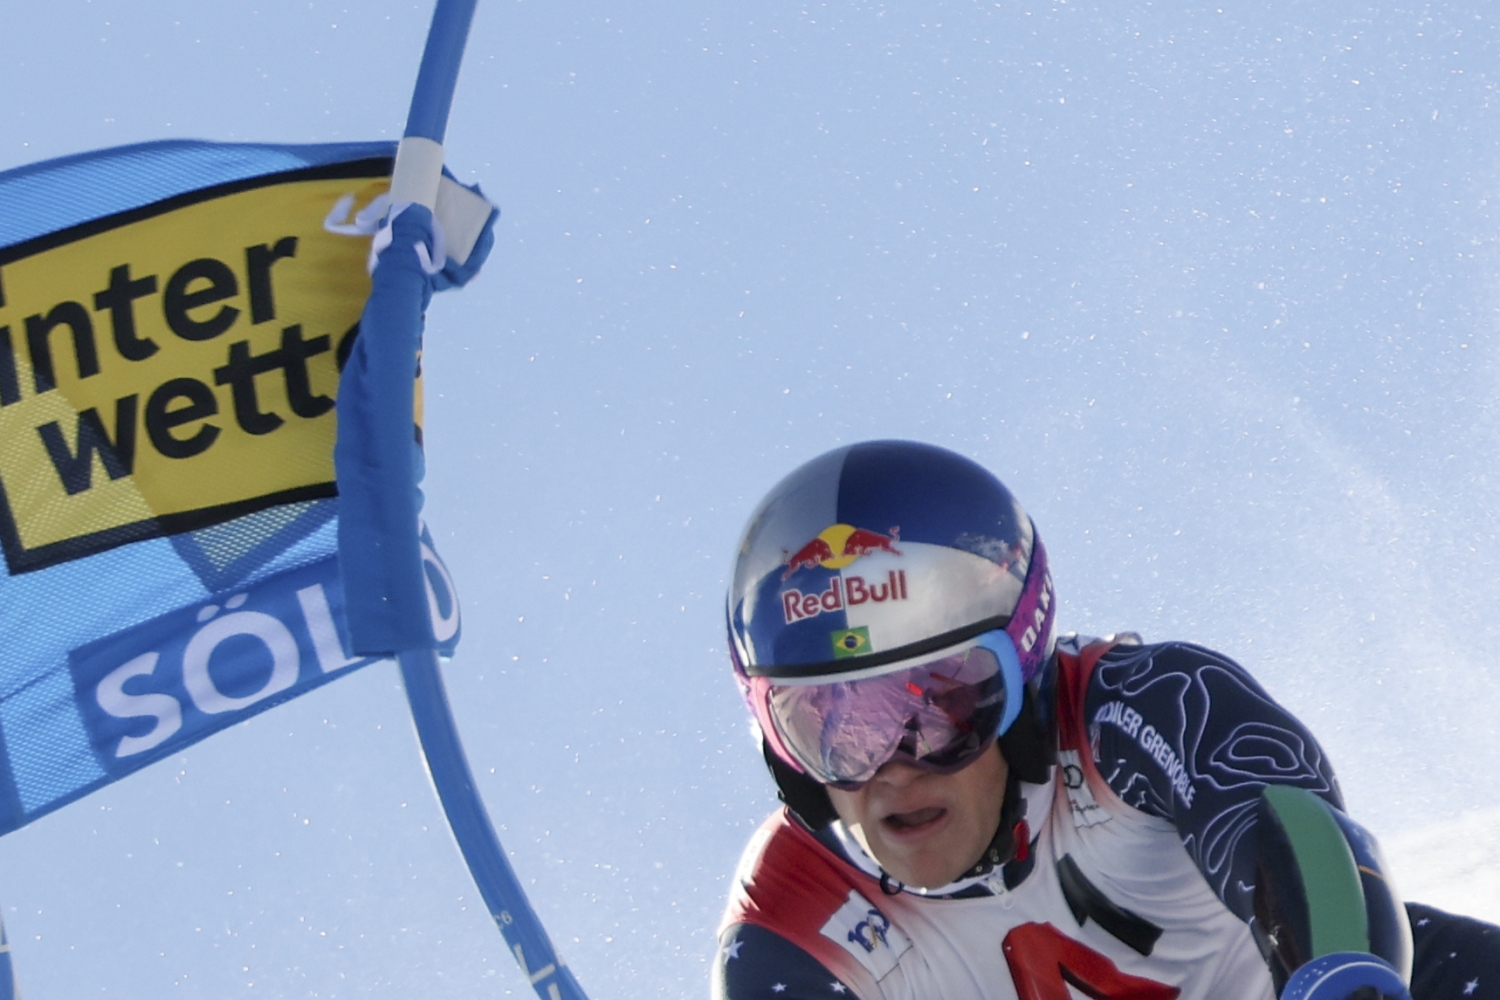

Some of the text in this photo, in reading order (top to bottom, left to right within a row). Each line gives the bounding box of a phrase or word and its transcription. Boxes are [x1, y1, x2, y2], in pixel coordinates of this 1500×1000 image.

[37, 319, 360, 496] wett
[782, 569, 908, 625] Red Bull
[1140, 724, 1197, 809] GRENOBLE
